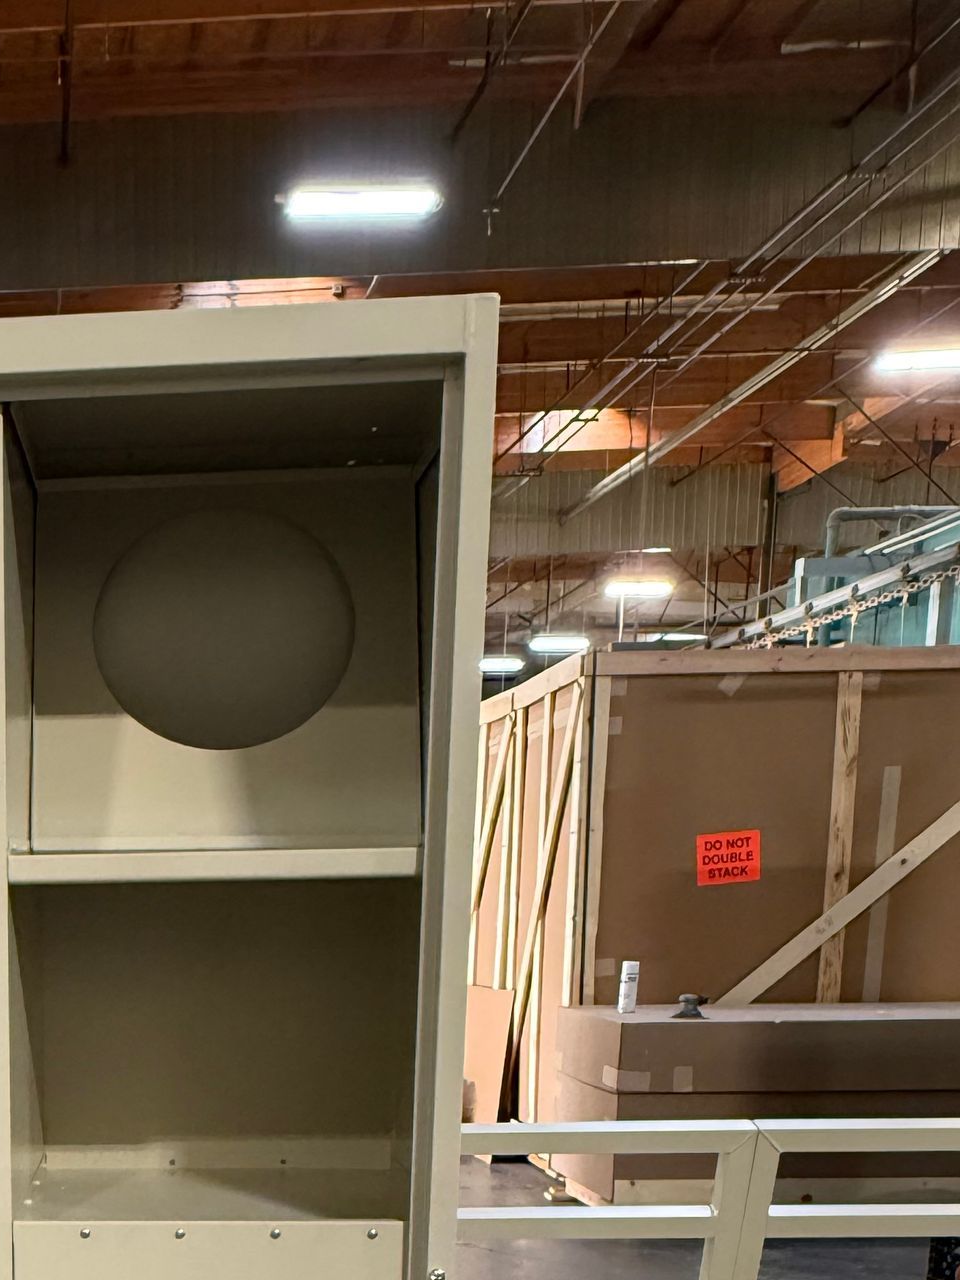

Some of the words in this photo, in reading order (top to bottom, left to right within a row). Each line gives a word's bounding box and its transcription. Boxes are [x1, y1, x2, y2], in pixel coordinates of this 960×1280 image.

[704, 840, 723, 851] DO
[726, 836, 752, 850] NOT
[702, 850, 754, 866] DOUBLE
[708, 865, 749, 879] STACK
